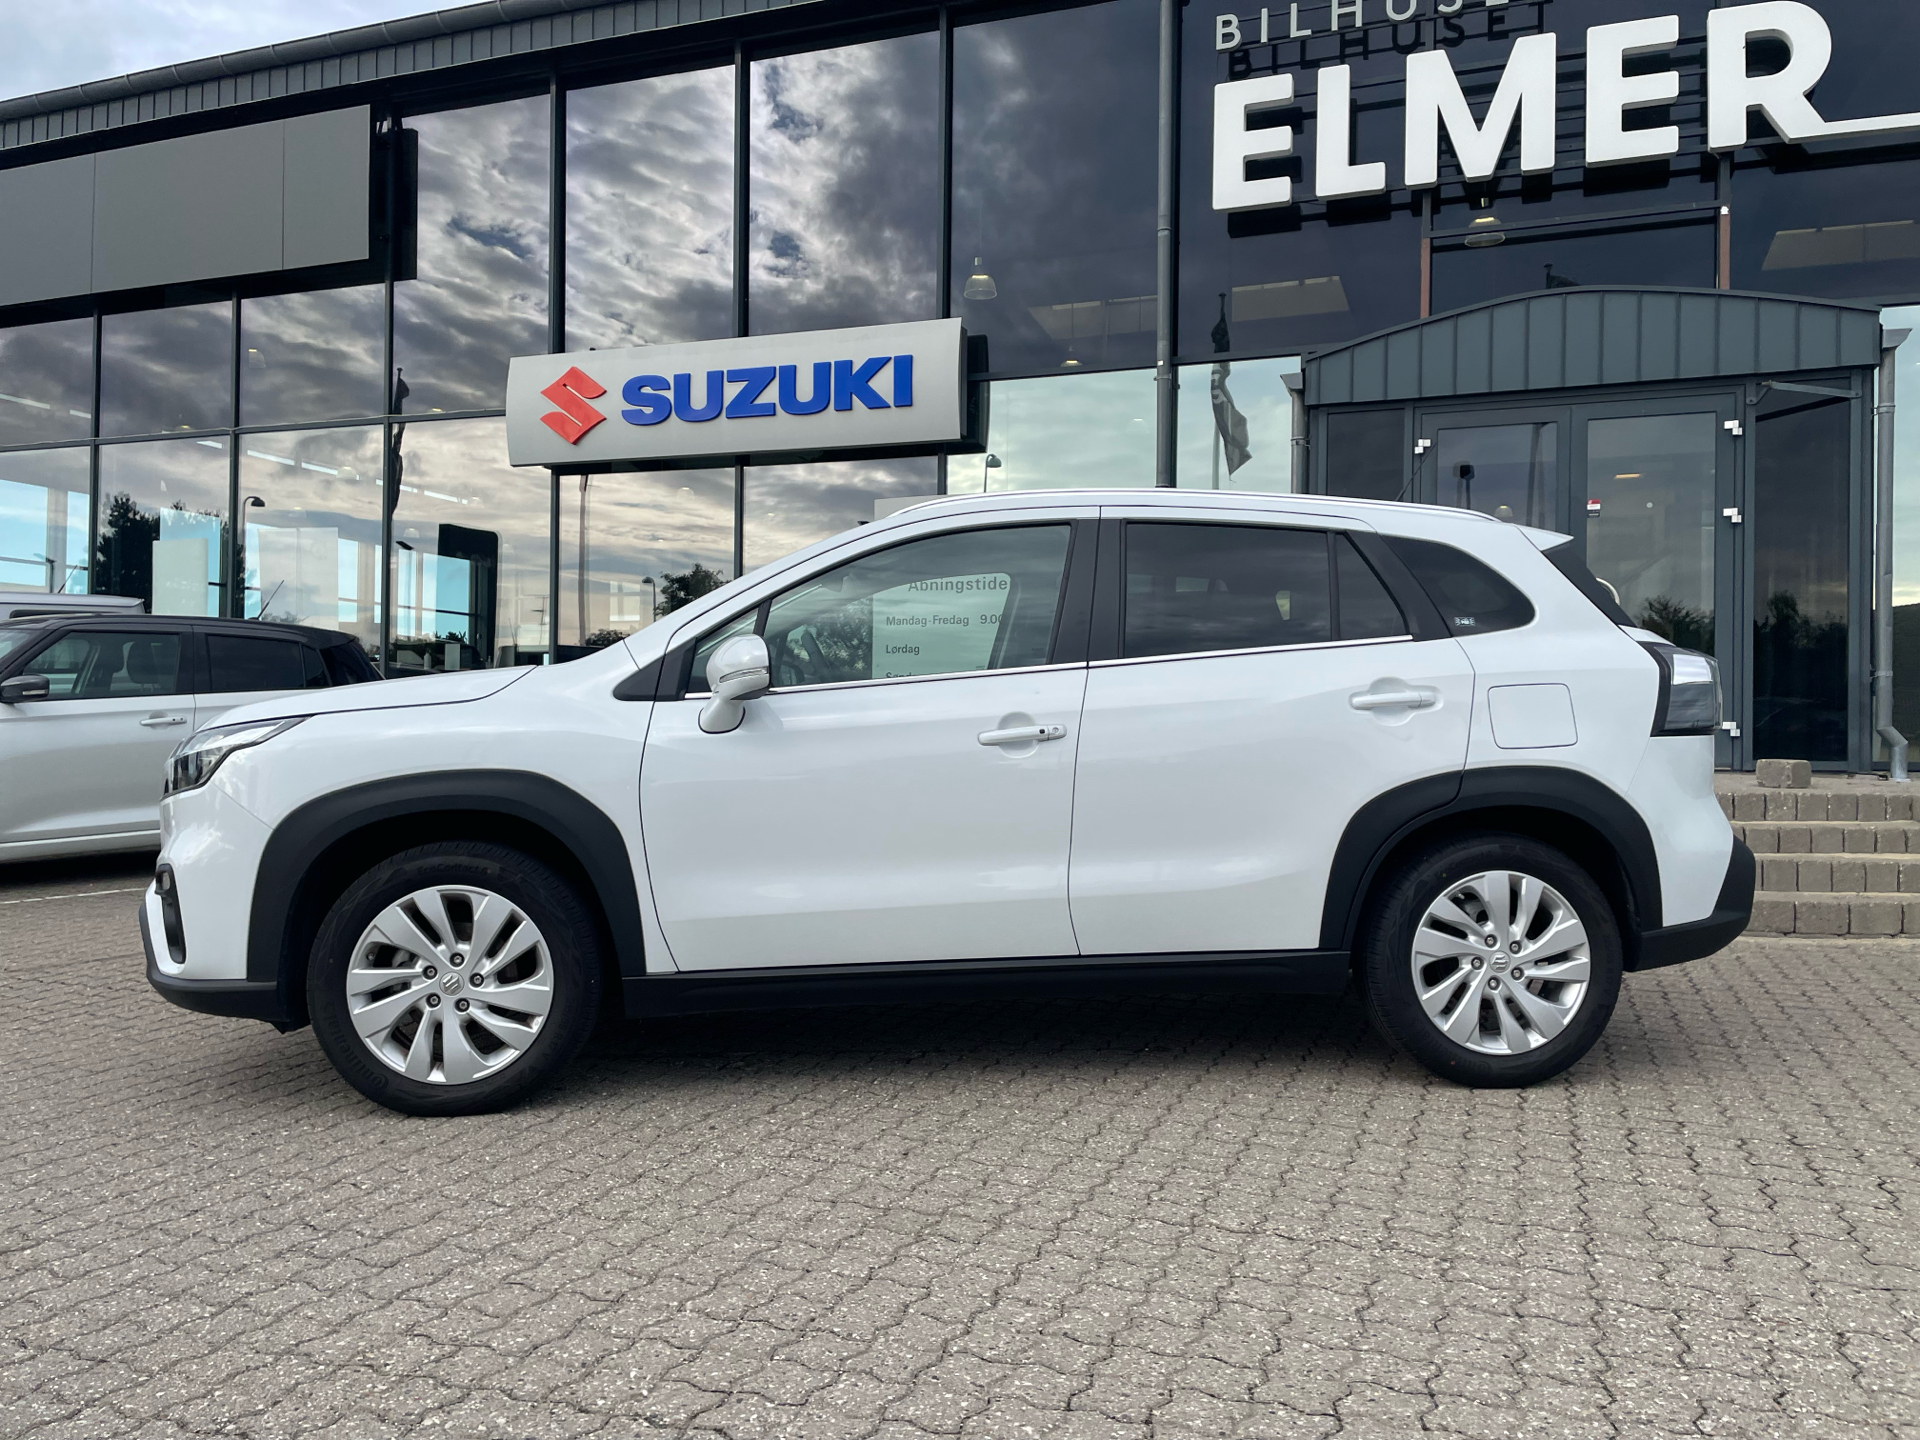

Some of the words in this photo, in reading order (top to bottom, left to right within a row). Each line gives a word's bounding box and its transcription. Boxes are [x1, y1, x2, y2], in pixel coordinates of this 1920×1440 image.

[1212, 0, 1833, 212] ELMER
[621, 354, 913, 426] SUZUKI
[886, 644, 920, 655] Lørdag
